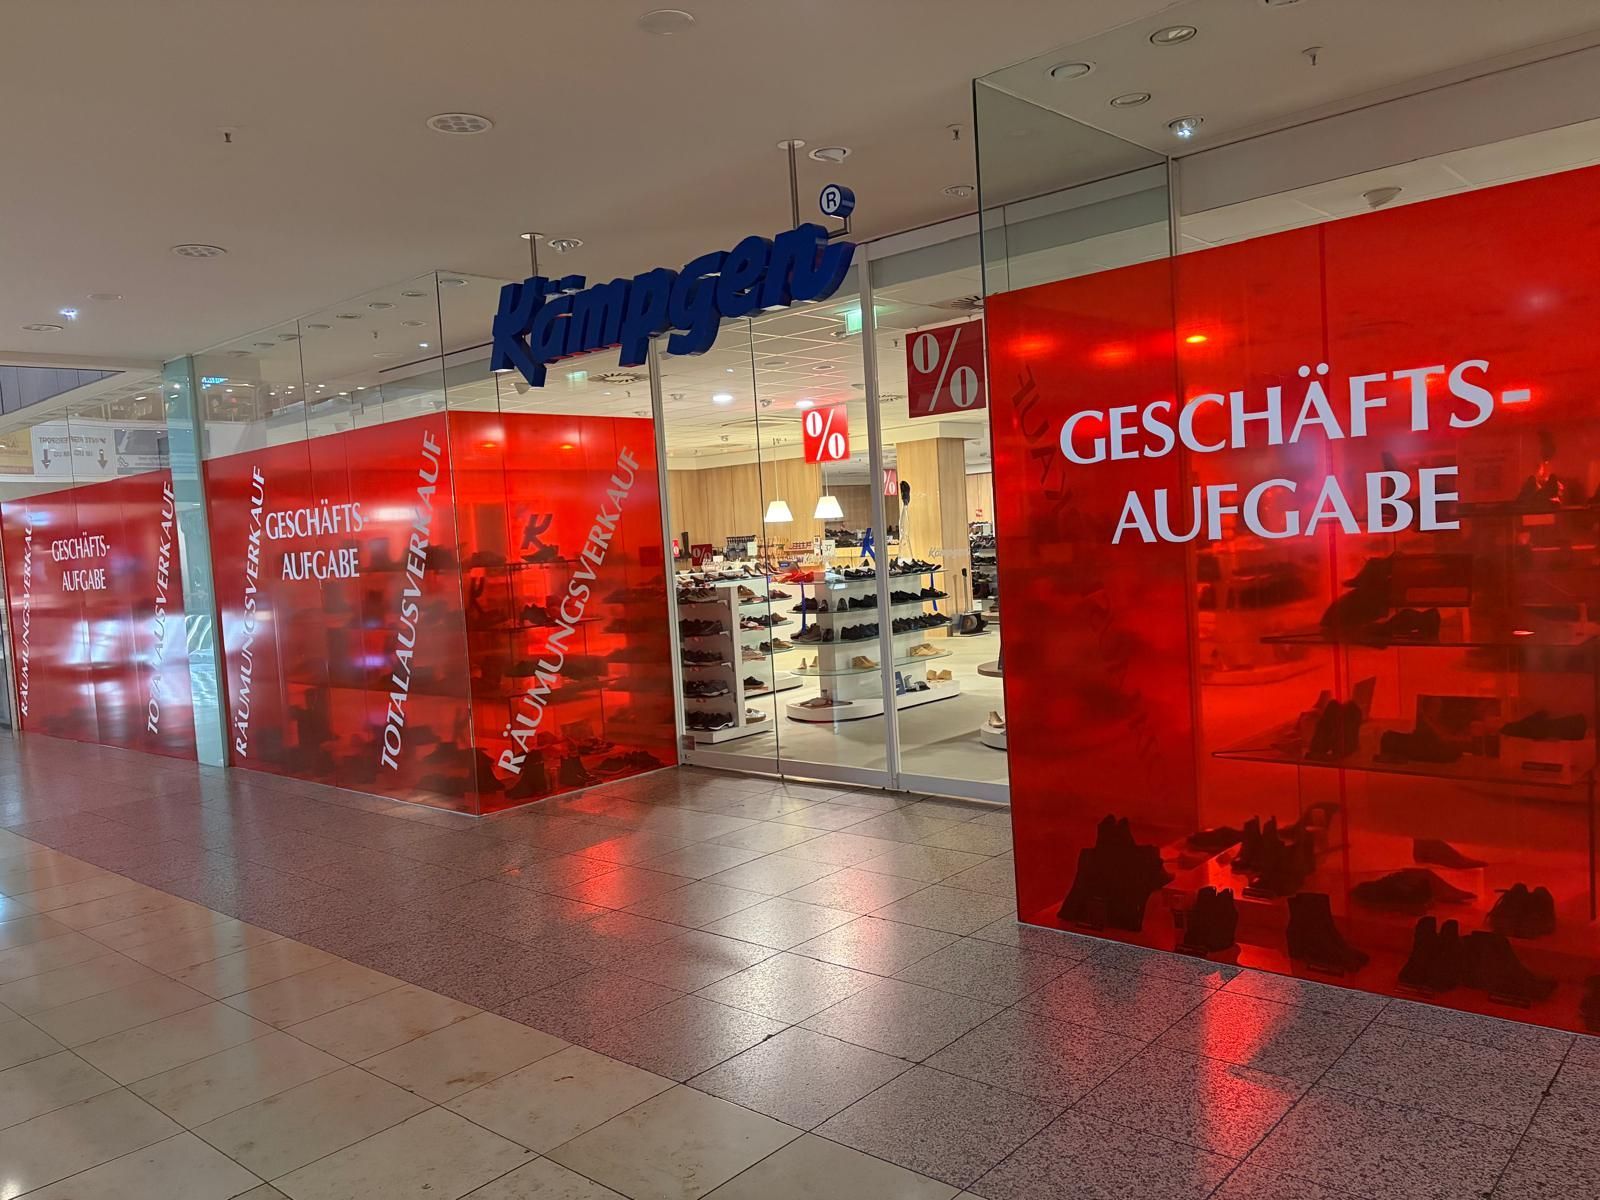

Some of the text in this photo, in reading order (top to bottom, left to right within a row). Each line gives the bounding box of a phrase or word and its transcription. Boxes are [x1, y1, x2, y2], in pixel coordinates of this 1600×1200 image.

[490, 222, 856, 387] Kämpgen
[1059, 359, 1531, 465] GESCHÄFTS-
[52, 532, 111, 561] GESCHÄFTS-
[265, 499, 369, 541] GESCHÄFTS-
[1111, 466, 1460, 545] AUFGABE
[20, 512, 33, 717] RÄUMUNGSVERKAU
[62, 568, 107, 592] AUFGABE
[235, 465, 265, 758] RÄUMUNGSVERKAUF
[281, 547, 360, 581] AUFGABE
[381, 430, 443, 771] TOTALAUSVERKAUF
[498, 446, 640, 775] RÄUMUNGSVERKAUF
